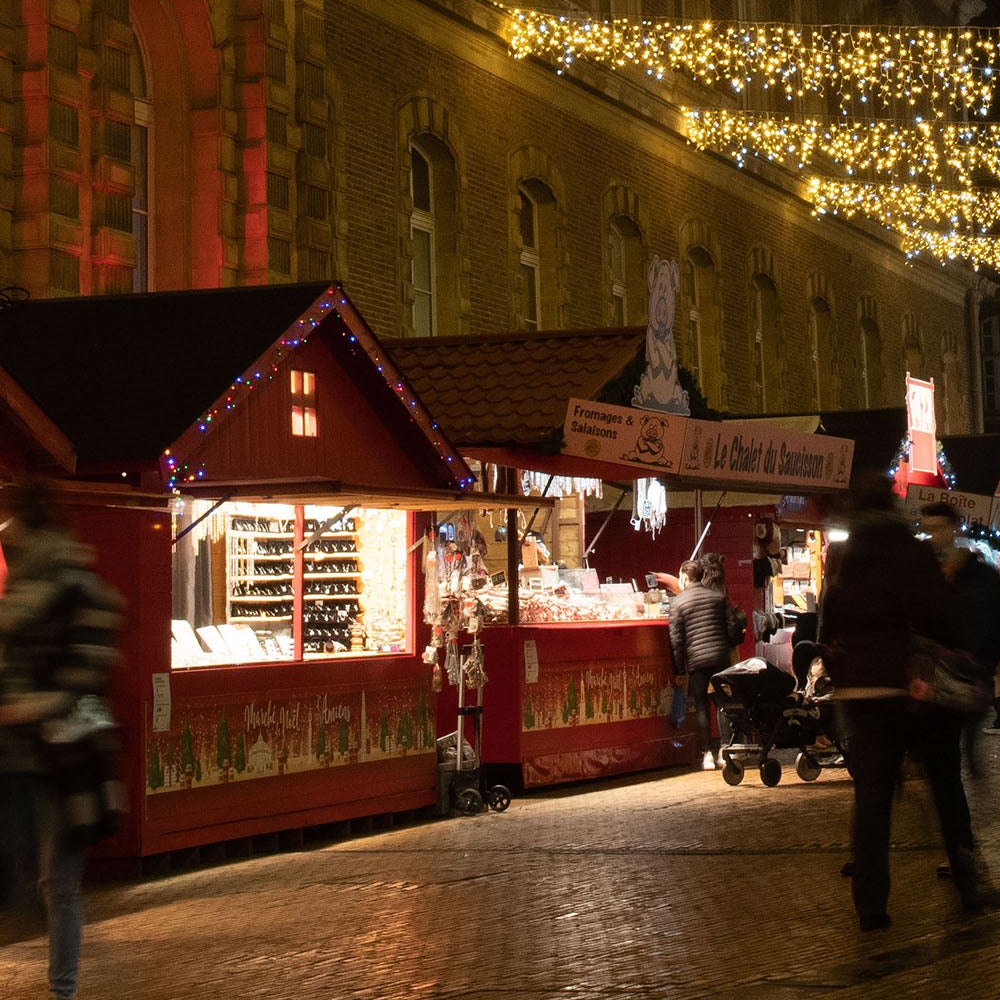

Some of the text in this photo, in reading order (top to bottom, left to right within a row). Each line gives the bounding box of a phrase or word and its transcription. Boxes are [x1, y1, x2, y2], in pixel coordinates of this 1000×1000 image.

[573, 404, 635, 426] Fromages &
[570, 421, 619, 440] Salaisons
[713, 433, 728, 471] Le
[729, 435, 764, 475] Chalet
[763, 446, 777, 475] du
[778, 442, 825, 479] Saucisson
[918, 488, 976, 509] La Boîte
